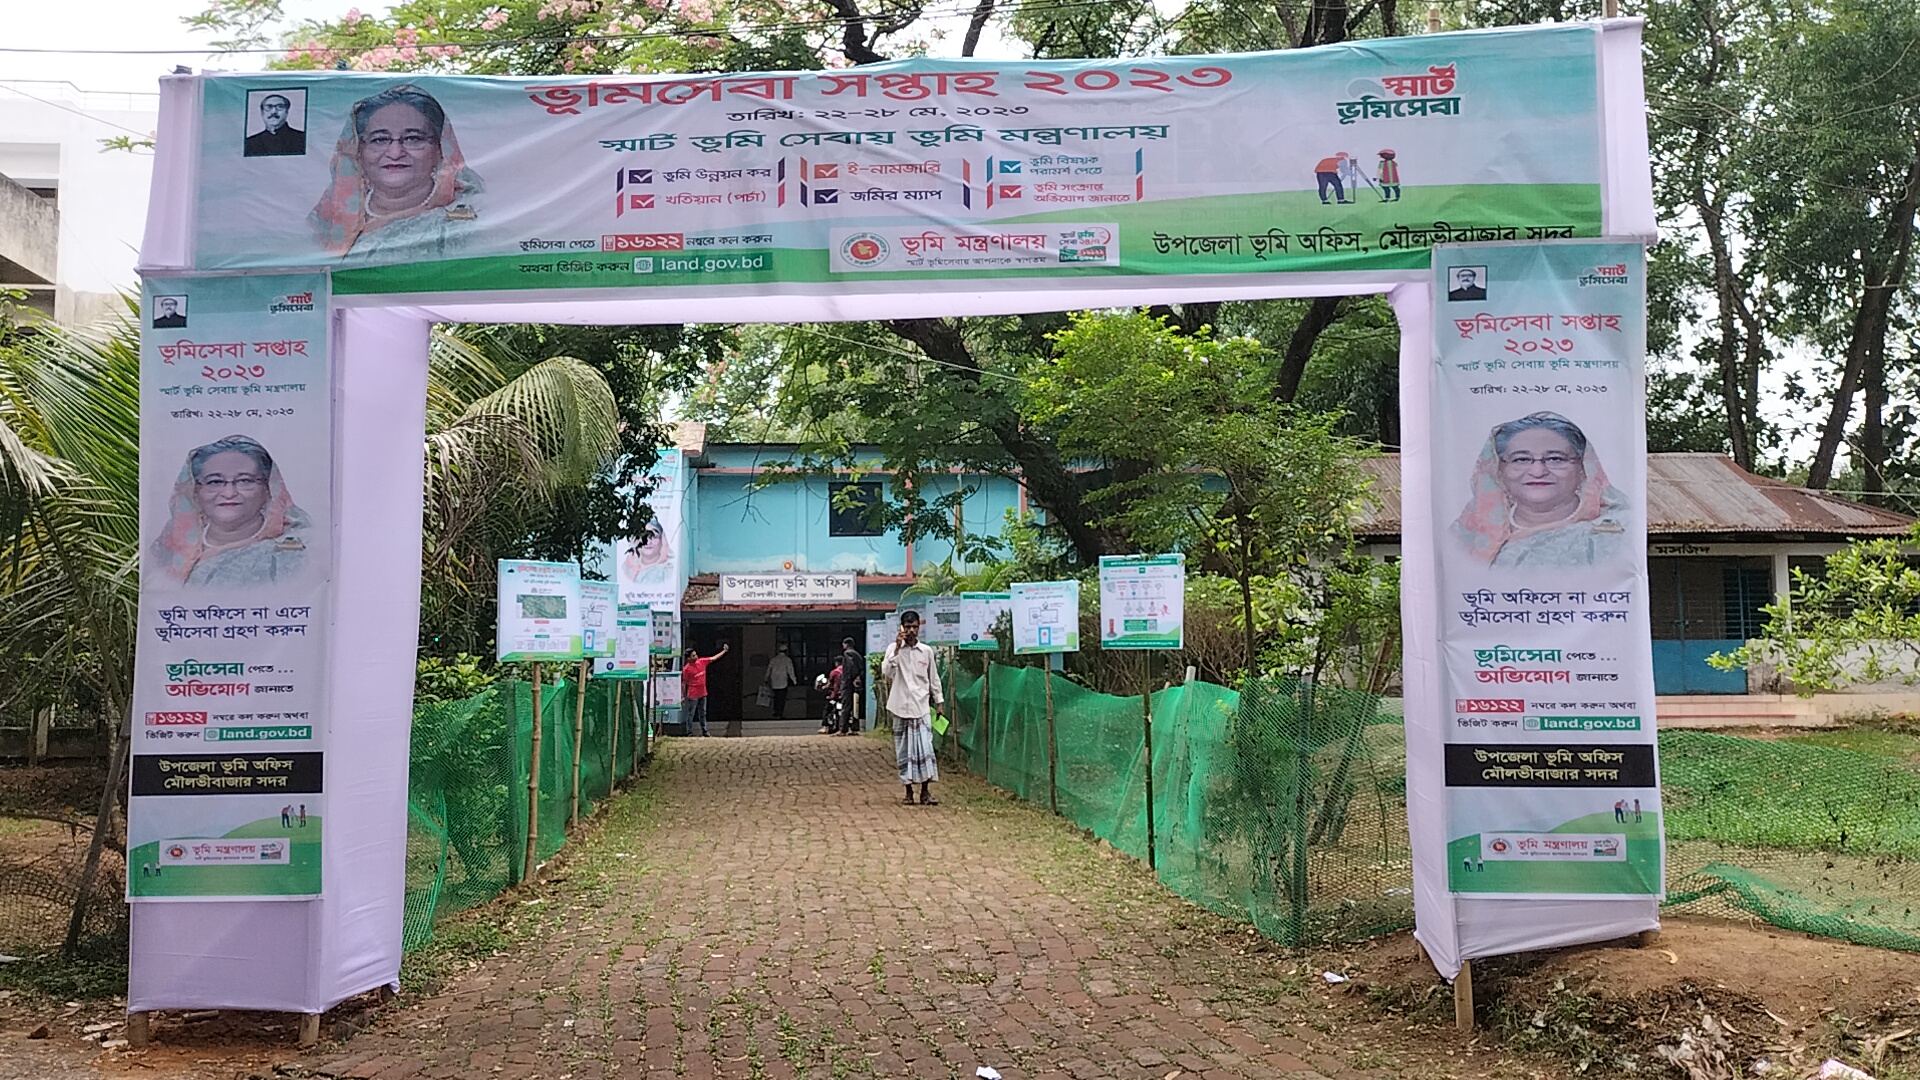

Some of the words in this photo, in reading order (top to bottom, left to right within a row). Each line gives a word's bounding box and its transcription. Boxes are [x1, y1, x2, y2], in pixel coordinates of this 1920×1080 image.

[1382, 63, 1457, 96] স্মার্ট
[525, 77, 799, 115] ভূমিসেবা
[816, 71, 1000, 100] সপ্তাহ
[1024, 67, 1232, 95] ২০২৩
[814, 109, 900, 120] ২২-২৮
[909, 105, 946, 119] মে,
[956, 105, 1029, 118] ২০২৩
[1336, 96, 1461, 124] ভূমিসেবা
[599, 133, 677, 152] স্মার্ট
[689, 130, 767, 153] ভূমি
[780, 131, 896, 147] সেবায়
[907, 124, 986, 147] ভূমি
[997, 125, 1170, 146] মন্ত্রণালয়
[662, 169, 691, 182] ভূমি
[695, 168, 742, 182] উন্নয়ন
[746, 168, 772, 178] কর
[847, 160, 941, 175] ই-নামজারি
[665, 193, 721, 205] খতিয়ান
[726, 190, 766, 203] (পর্চা)
[850, 187, 897, 201] জমির
[902, 189, 942, 200] ম্যাপ
[1034, 193, 1083, 202] অভিযোগ
[1088, 194, 1130, 203] জানাতে
[519, 238, 565, 252] ভূমিসেবা
[569, 240, 595, 249] পেতে
[617, 236, 680, 249] ১৬১২২
[718, 236, 738, 244] কল
[742, 234, 772, 244] করুন
[900, 231, 945, 254] ভূমি
[954, 233, 1047, 253] মন্ত্রণালয়
[1152, 231, 1242, 255] উপজেলা
[1248, 229, 1290, 258] ভূমি
[1294, 226, 1369, 255] অফিস,
[519, 263, 553, 273] অথবা
[556, 261, 593, 272] ভিজিট
[597, 262, 629, 272] করুন
[661, 256, 763, 273] land.gov.bd
[1578, 275, 1628, 286] ভূমিসেবা
[270, 303, 313, 314] ভূমিসেবা
[1453, 312, 1554, 340] ভূমিসেবা
[1560, 313, 1623, 333] সপ্তাহ
[158, 339, 246, 365] ভূমিসেবা
[252, 339, 308, 357] সপ্তাহ
[1504, 338, 1573, 355] ২০২৩
[201, 364, 265, 381] ২০২৩
[1457, 360, 1481, 371] স্মার্ট
[1484, 359, 1506, 373] ভূমি
[1511, 360, 1545, 369] সেবায়
[1548, 358, 1569, 372] ভূমি
[1574, 360, 1620, 369] মন্ত্রণালয়
[159, 385, 180, 396] স্মার্ট
[183, 384, 203, 398] ভূমি
[207, 385, 238, 395] সেবায়
[241, 382, 261, 397] ভূমি
[265, 383, 307, 393] মন্ত্রণালয়
[1512, 385, 1550, 393] ২২-২৮
[1554, 384, 1571, 394] মে,
[1576, 384, 1607, 393] ২০২৩
[208, 409, 242, 418] ২২-২৮
[246, 408, 262, 418] মে,
[266, 408, 294, 416] ২০২৩
[1655, 543, 1710, 554] মসজিদ
[726, 577, 779, 589] উপজেলা
[784, 575, 808, 591] ভূমি
[813, 575, 850, 588] অফিস
[1462, 588, 1497, 608] ভূমি
[1501, 588, 1562, 604] অফিসে
[1567, 591, 1586, 604] না
[1593, 591, 1631, 604] এসে
[158, 606, 188, 623] ভূমি
[193, 605, 246, 620] অফিসে
[251, 607, 270, 619] না
[275, 606, 311, 618] এসে
[1458, 607, 1532, 628] ভূমিসেবা
[1536, 610, 1576, 625] গ্রহণ
[1580, 610, 1629, 623] করুন
[154, 623, 219, 643] ভূমিসেবা
[222, 625, 259, 639] গ্রহণ
[263, 624, 308, 637] করুন
[1473, 644, 1562, 668] ভূমিসেবা
[1566, 652, 1596, 661] পেতে
[166, 659, 244, 682] ভূমিসেবা
[248, 665, 274, 673] পেতে
[1474, 666, 1570, 684] অভিযোগ
[1576, 673, 1618, 682] জানাতে
[166, 680, 250, 697] অভিযোগ
[254, 685, 294, 694] জানাতে
[1470, 700, 1521, 712] ১৬১২২
[1531, 702, 1556, 710] নম্বরে
[1581, 702, 1605, 710] করুন
[1609, 701, 1636, 710] অথবা
[158, 712, 204, 724] ১৬১২২
[213, 713, 235, 722] নম্বরে
[257, 712, 280, 720] করুন
[284, 711, 309, 720] অথবা
[1457, 718, 1488, 728] ভিজিট
[1491, 720, 1518, 728] করুন
[1544, 718, 1636, 730] land.gov.bd
[146, 729, 173, 740] ভিজিট
[176, 731, 201, 739] করুন
[222, 728, 308, 739] land.gov.bd
[158, 759, 216, 773] উপজেলা
[220, 757, 249, 774] ভূমি
[252, 756, 294, 771] অফিস
[1474, 749, 1539, 764] উপজেলা
[1543, 750, 1574, 767] ভূমি
[1578, 749, 1624, 764] অফিস
[1482, 765, 1580, 781] মৌলভীবাজার
[1584, 767, 1619, 780] সদর
[164, 775, 253, 789] মৌলভীবাজার
[256, 775, 288, 787] সদর
[192, 843, 211, 855] ভূমি
[215, 844, 256, 855] মন্ত্রণালয়
[1517, 838, 1538, 851] ভূমি
[1543, 840, 1588, 850] মন্ত্রণালয়
